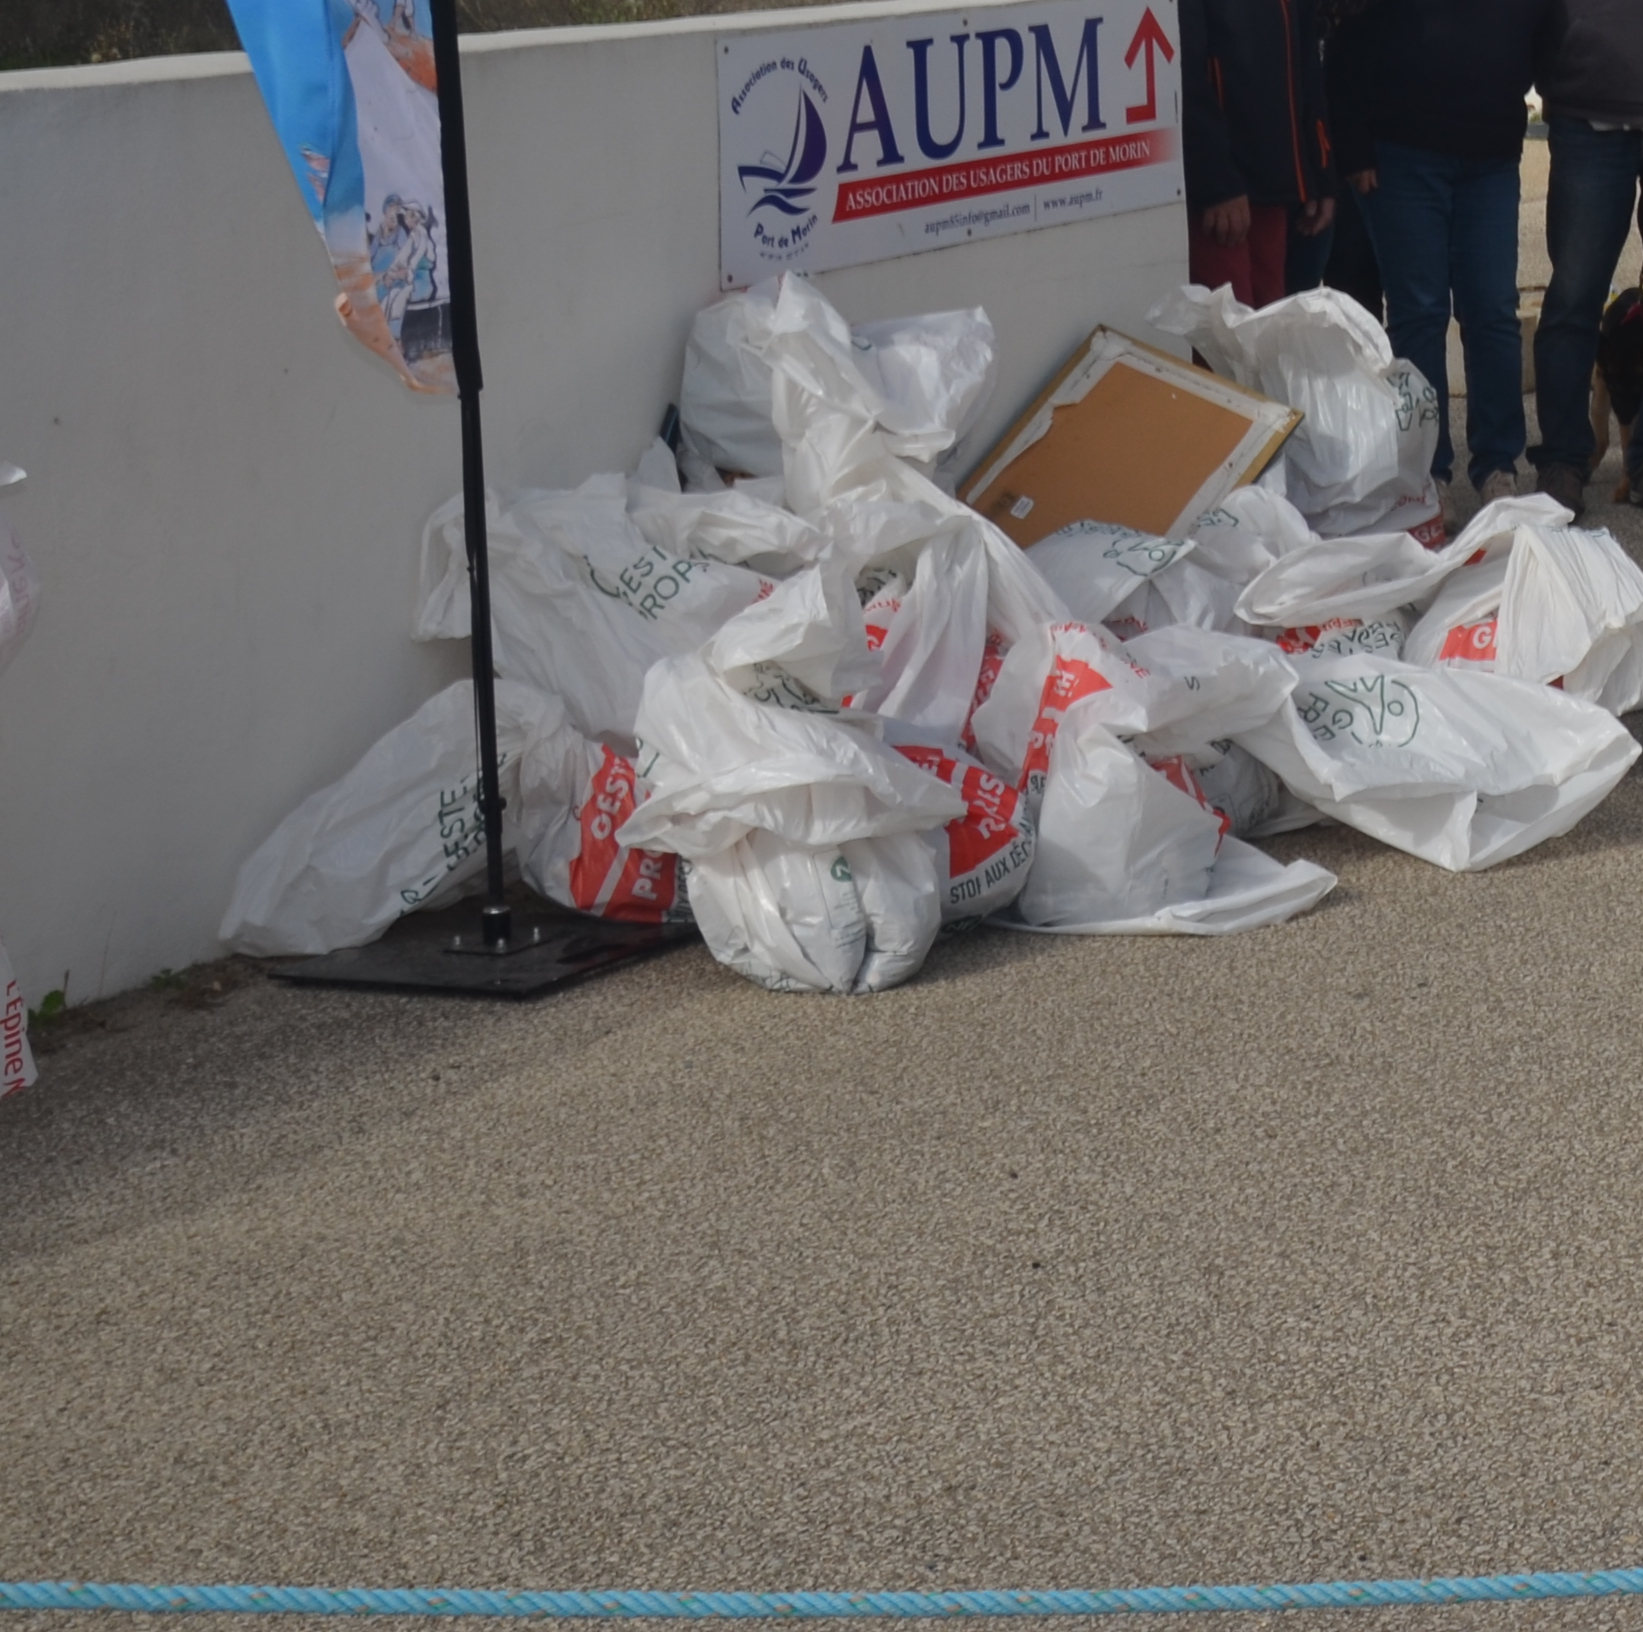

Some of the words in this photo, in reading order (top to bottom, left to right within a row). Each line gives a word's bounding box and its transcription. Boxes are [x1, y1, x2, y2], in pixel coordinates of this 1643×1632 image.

[731, 60, 778, 116] Association
[780, 56, 795, 71] des
[798, 56, 828, 103] Usagers
[836, 17, 1107, 175] AUPM
[845, 177, 941, 212] ASSOCIATION
[942, 171, 968, 194] DES
[969, 162, 1031, 189] USAGERS
[1032, 158, 1052, 178] DU
[1054, 150, 1089, 174] PORT
[1089, 147, 1107, 167] DE
[1108, 140, 1151, 164] MORIN
[1043, 188, 1104, 211] www.aupm.fr
[754, 222, 775, 249] Port
[778, 235, 789, 249] de
[790, 214, 818, 245] Morin
[984, 857, 1011, 890] AUX
